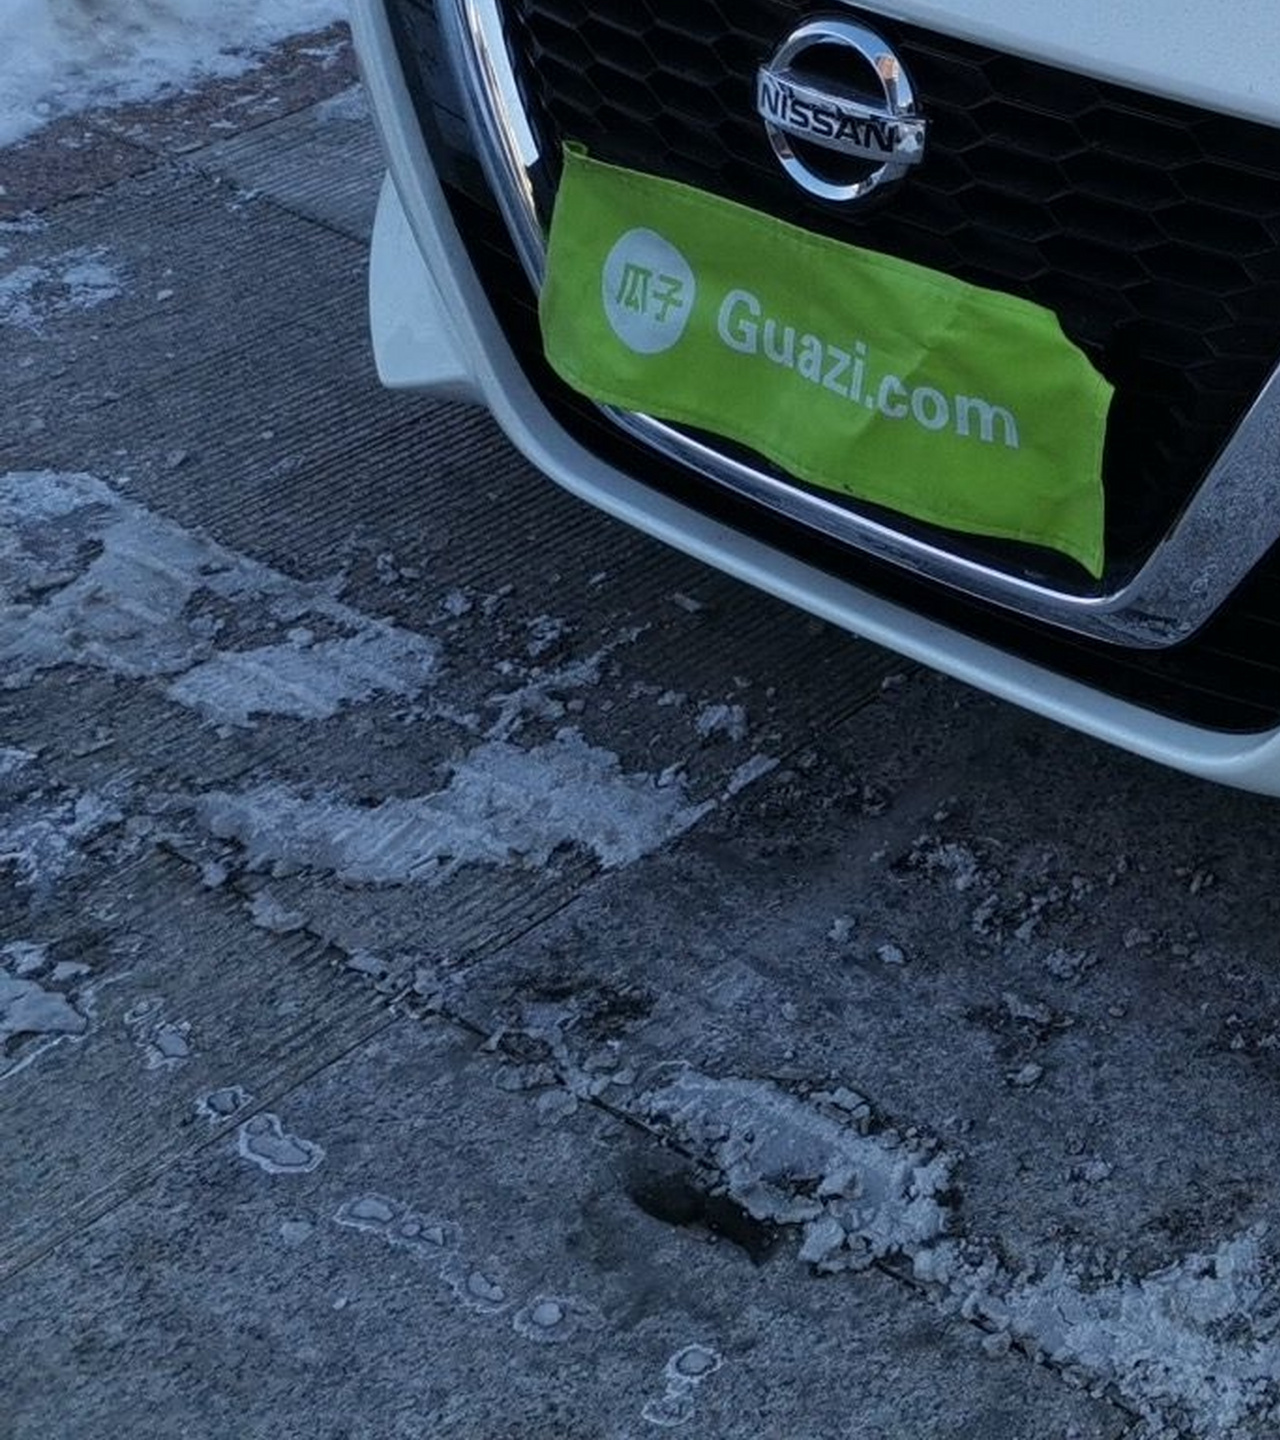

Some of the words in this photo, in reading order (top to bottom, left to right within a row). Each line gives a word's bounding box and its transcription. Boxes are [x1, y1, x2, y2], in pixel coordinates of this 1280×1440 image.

[758, 80, 897, 152] NISSAN
[615, 263, 684, 323] 瓜子
[716, 289, 1020, 448] Guazi.com
